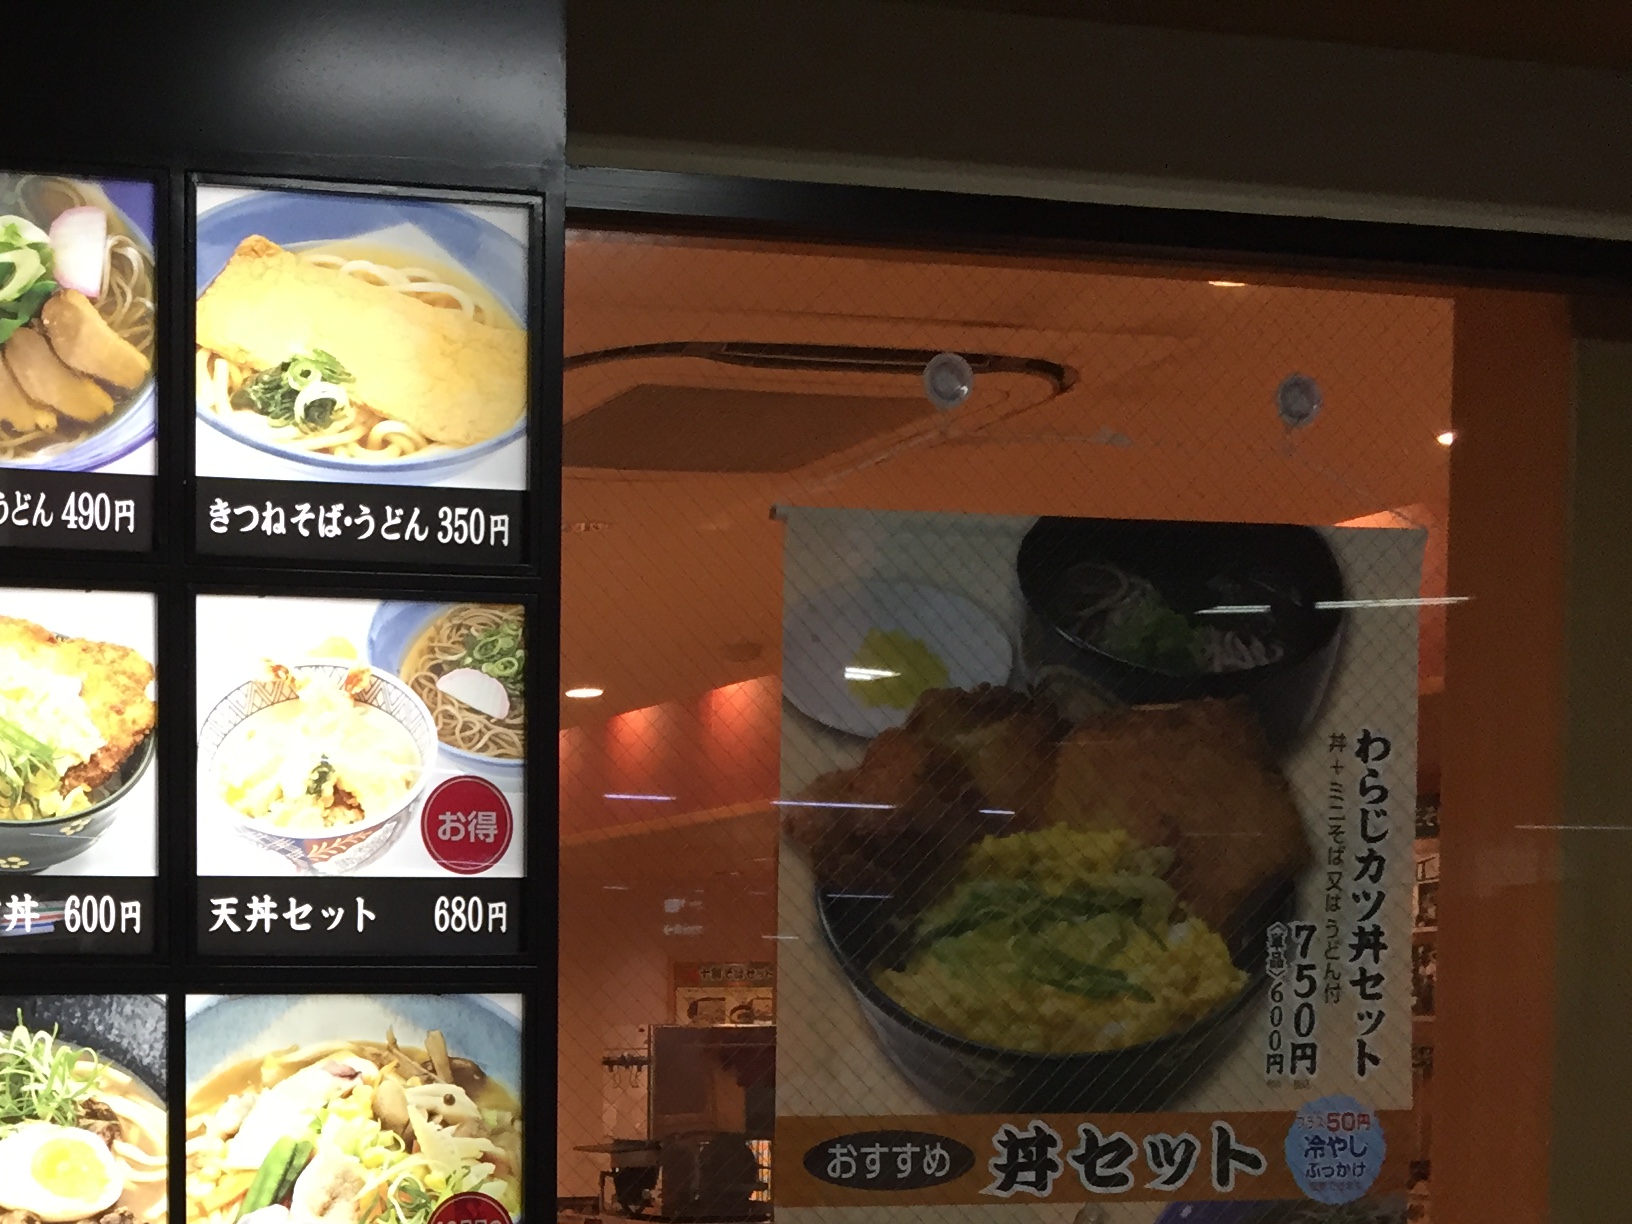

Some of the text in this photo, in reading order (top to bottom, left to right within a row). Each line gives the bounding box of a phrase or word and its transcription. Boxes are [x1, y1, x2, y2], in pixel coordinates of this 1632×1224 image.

[61, 491, 136, 533] 490円
[209, 497, 509, 547] きつねそば・うどん 350円
[437, 811, 499, 843] お得
[64, 895, 142, 934] 600円
[208, 894, 508, 933] 天丼セット 680円
[1348, 727, 1392, 1078] わらじカツ丼セット
[1290, 923, 1319, 1076] 750円
[826, 1143, 951, 1180] おすすめ
[979, 1119, 1267, 1199] 丼セット
[1303, 1134, 1368, 1159] 冷やし
